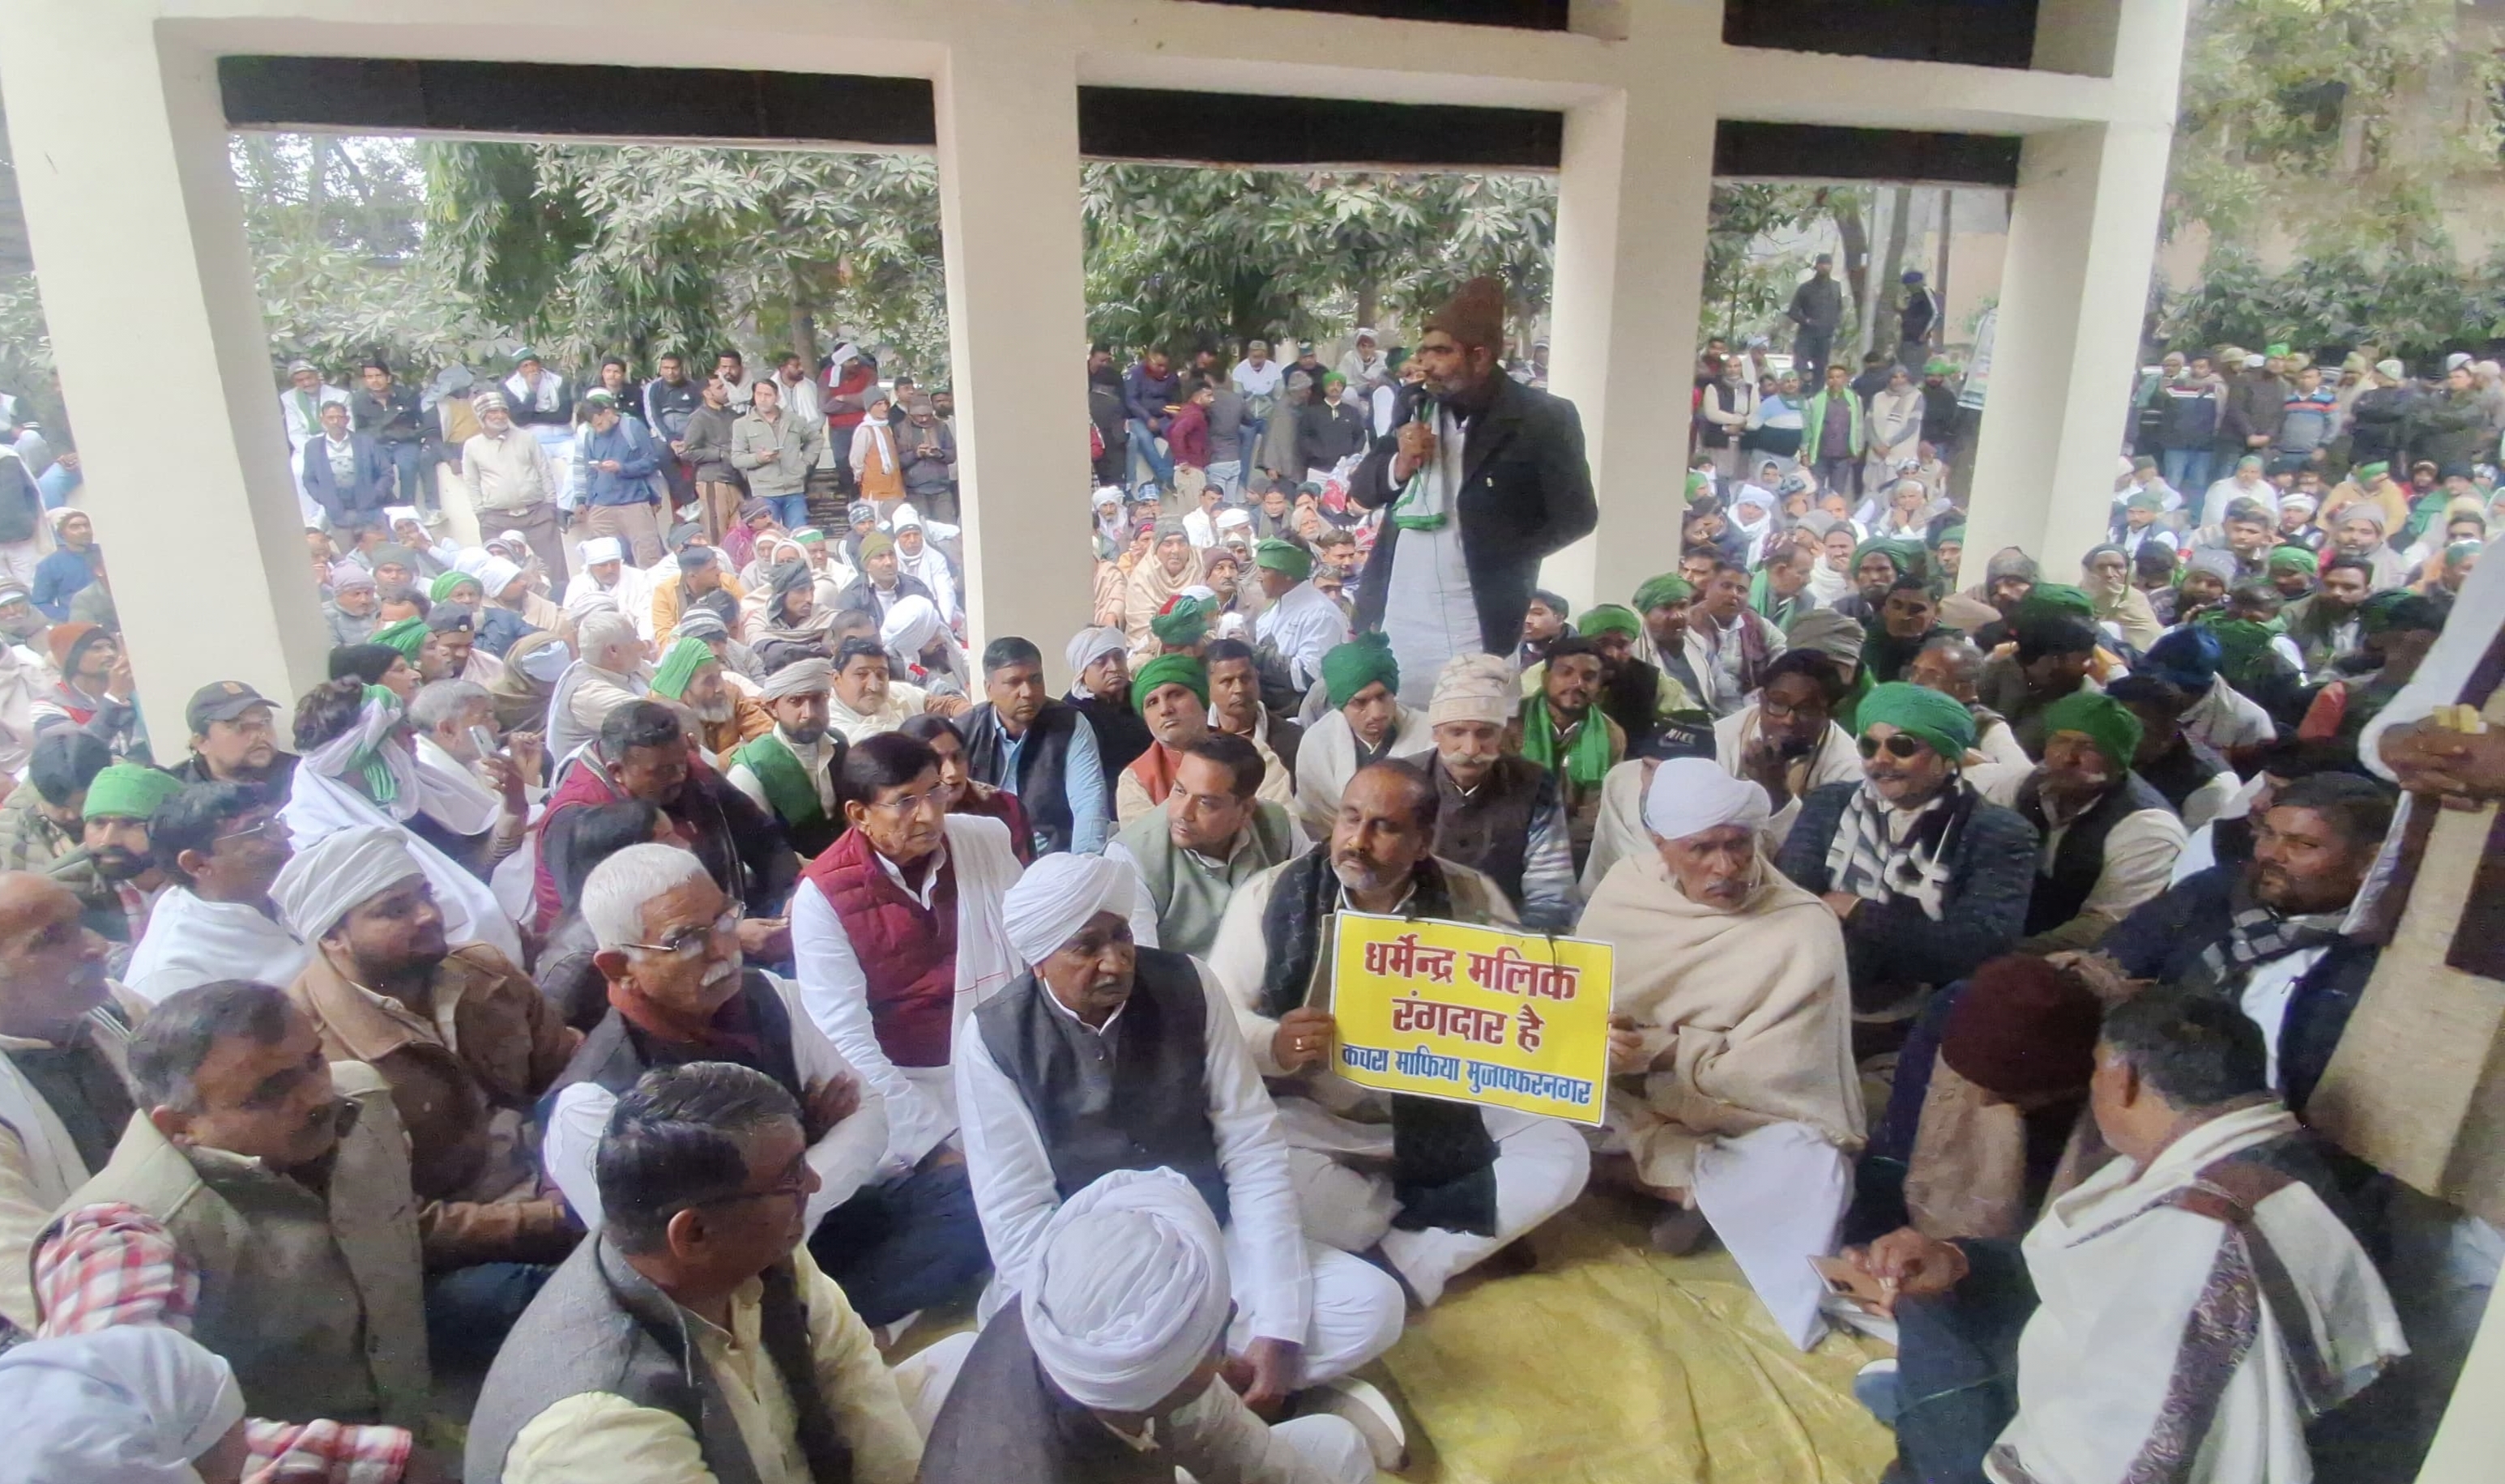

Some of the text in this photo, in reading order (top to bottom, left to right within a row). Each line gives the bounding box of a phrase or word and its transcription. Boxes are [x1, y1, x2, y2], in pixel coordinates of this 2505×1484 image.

[1365, 933, 1581, 1000] धर्मेन्द्र मलिक
[1392, 990, 1545, 1053] रंगदार है
[1341, 1043, 1593, 1104] कचरा माफिया मुजफ्फरनगर
